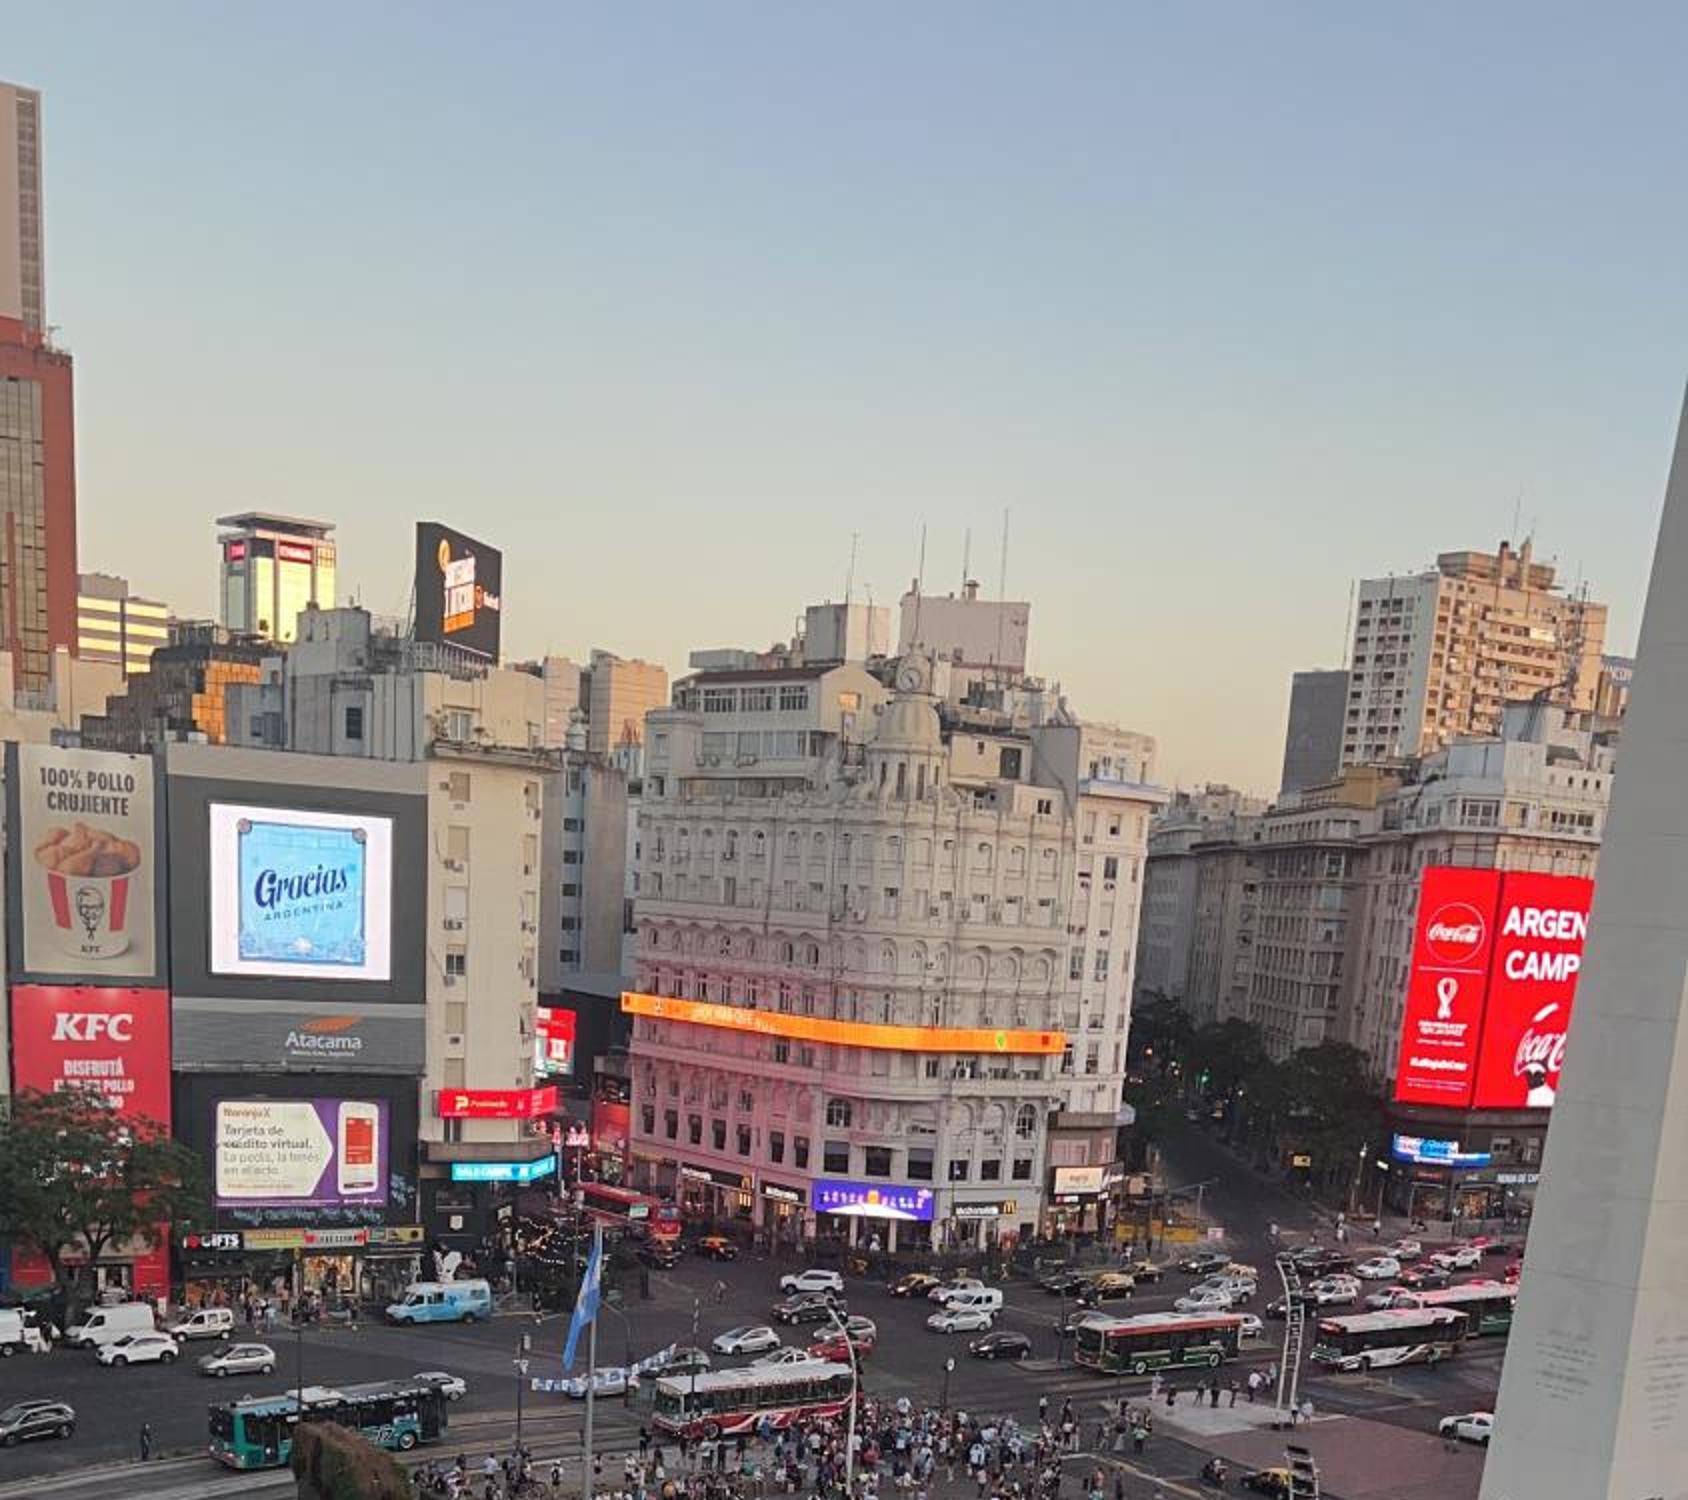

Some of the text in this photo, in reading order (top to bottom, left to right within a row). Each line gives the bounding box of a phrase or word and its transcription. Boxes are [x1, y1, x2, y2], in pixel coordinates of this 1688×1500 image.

[40, 767, 135, 793] 100% POLLO
[47, 791, 129, 816] CRUJIENTE
[254, 863, 347, 910] Gracias
[263, 901, 344, 921] ARGENTINA
[52, 1012, 133, 1041] KFC
[285, 1031, 362, 1049] Atacama
[63, 1056, 125, 1076] DISFRUTÁ
[224, 1123, 284, 1137] Tarjeta de
[271, 1138, 312, 1149] virtual.
